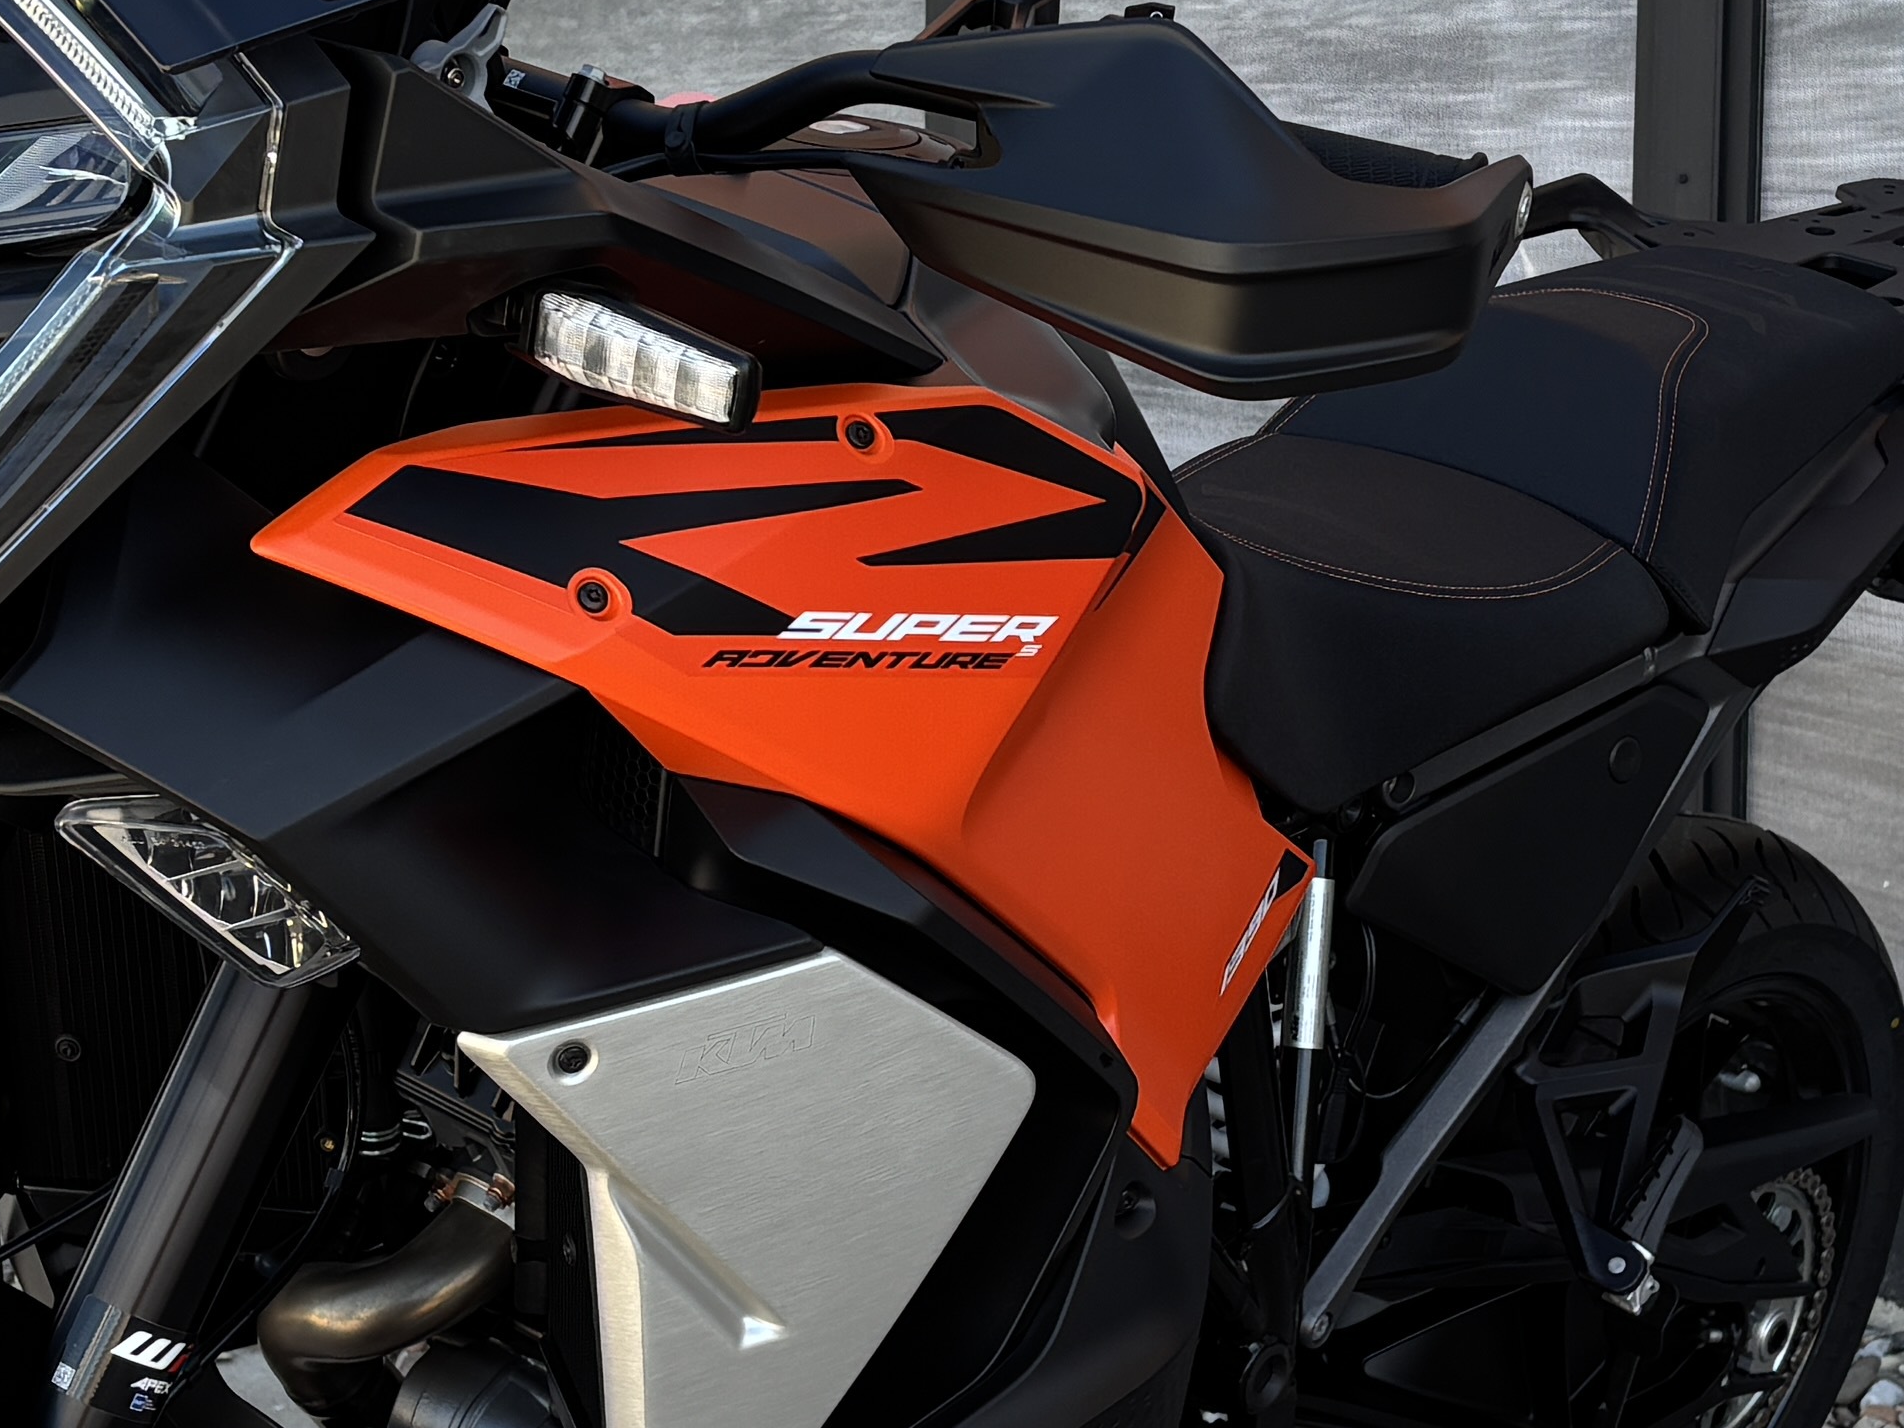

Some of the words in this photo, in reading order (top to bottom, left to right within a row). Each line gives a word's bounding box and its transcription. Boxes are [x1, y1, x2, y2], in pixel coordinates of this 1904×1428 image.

[776, 611, 1060, 642] SUPER
[701, 649, 1019, 670] ADVENTURE
[1015, 644, 1042, 657] S
[675, 1013, 815, 1085] KTM
[130, 1377, 172, 1395] APEX
